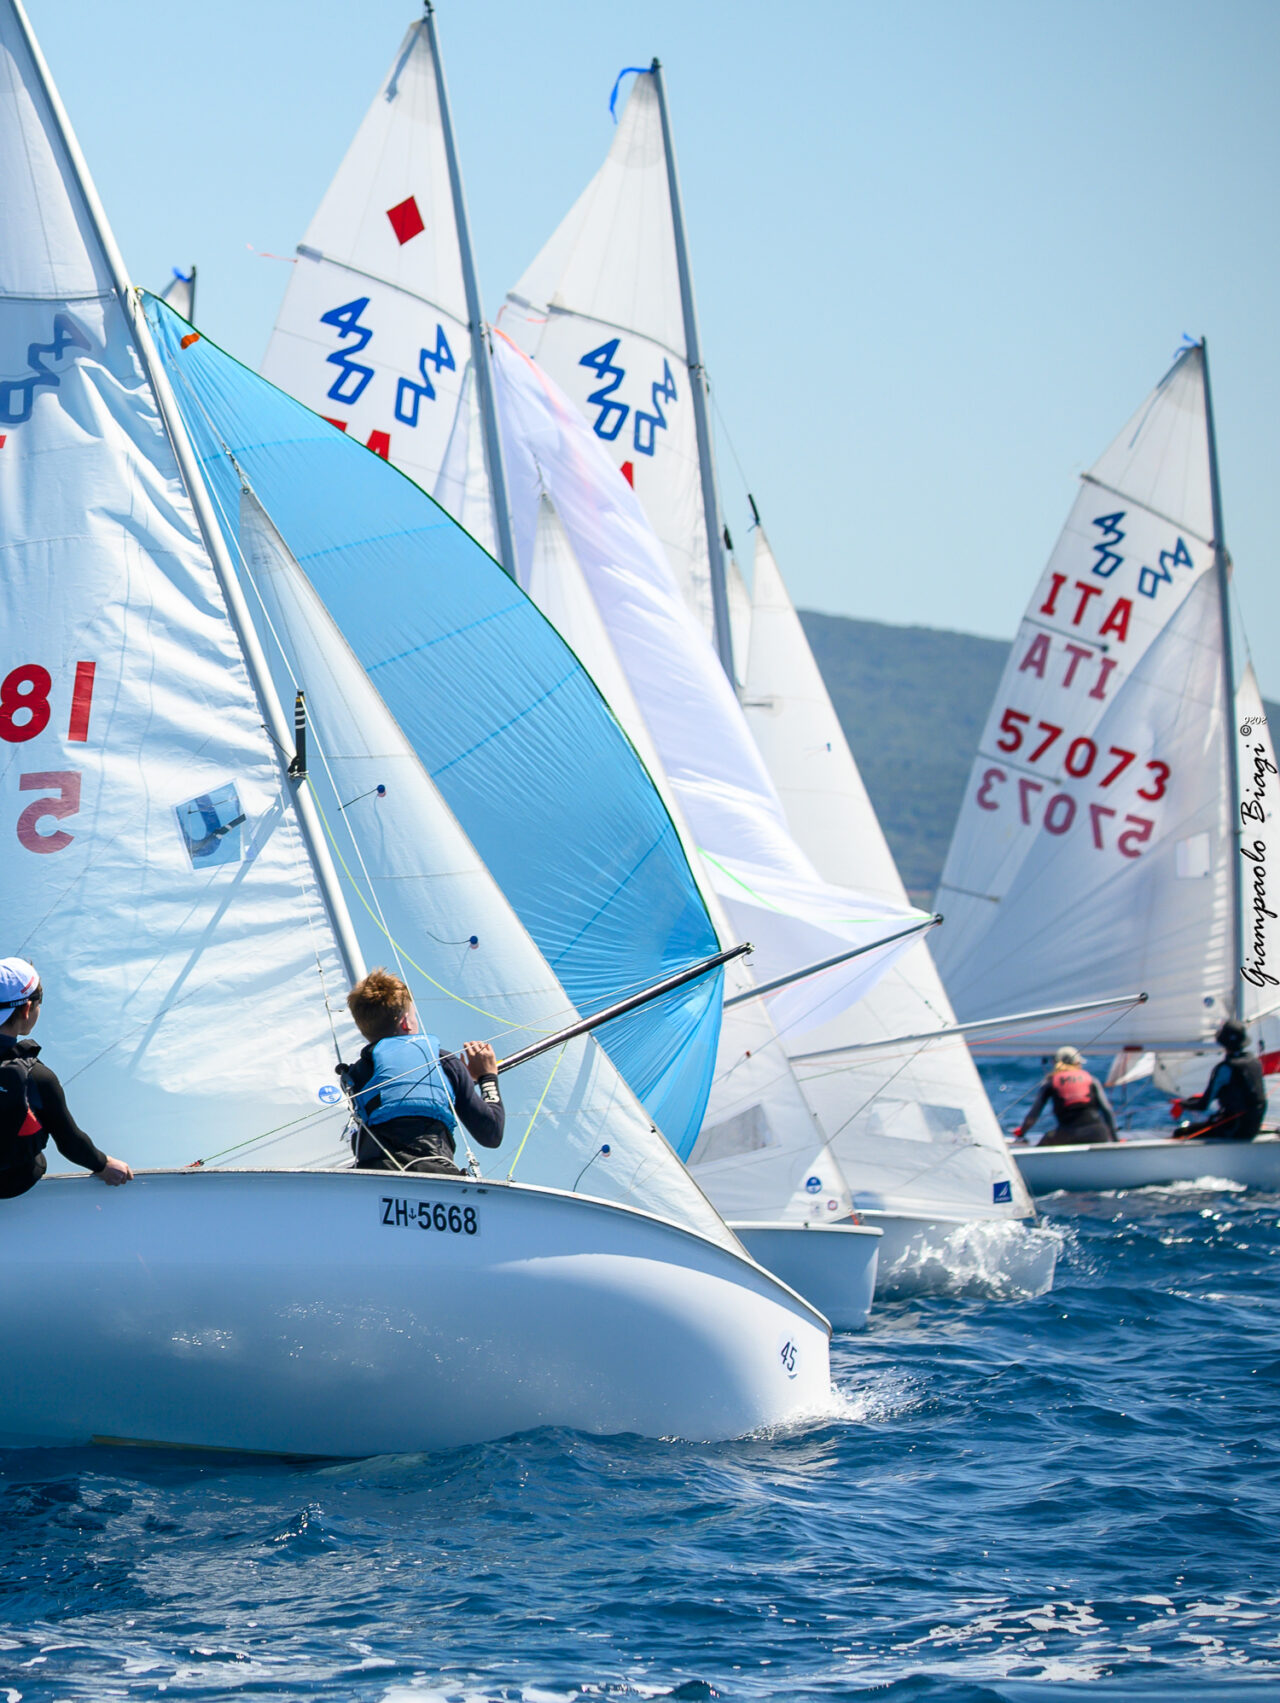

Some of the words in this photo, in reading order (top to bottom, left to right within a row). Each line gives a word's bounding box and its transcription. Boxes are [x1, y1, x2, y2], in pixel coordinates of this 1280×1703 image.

[320, 297, 374, 405] 420
[579, 338, 629, 441] 420
[1040, 572, 1133, 642] ITA
[996, 708, 1171, 802] 57073
[382, 1198, 408, 1226] ZH
[418, 1202, 477, 1235] 5668
[780, 1341, 798, 1372] 45
